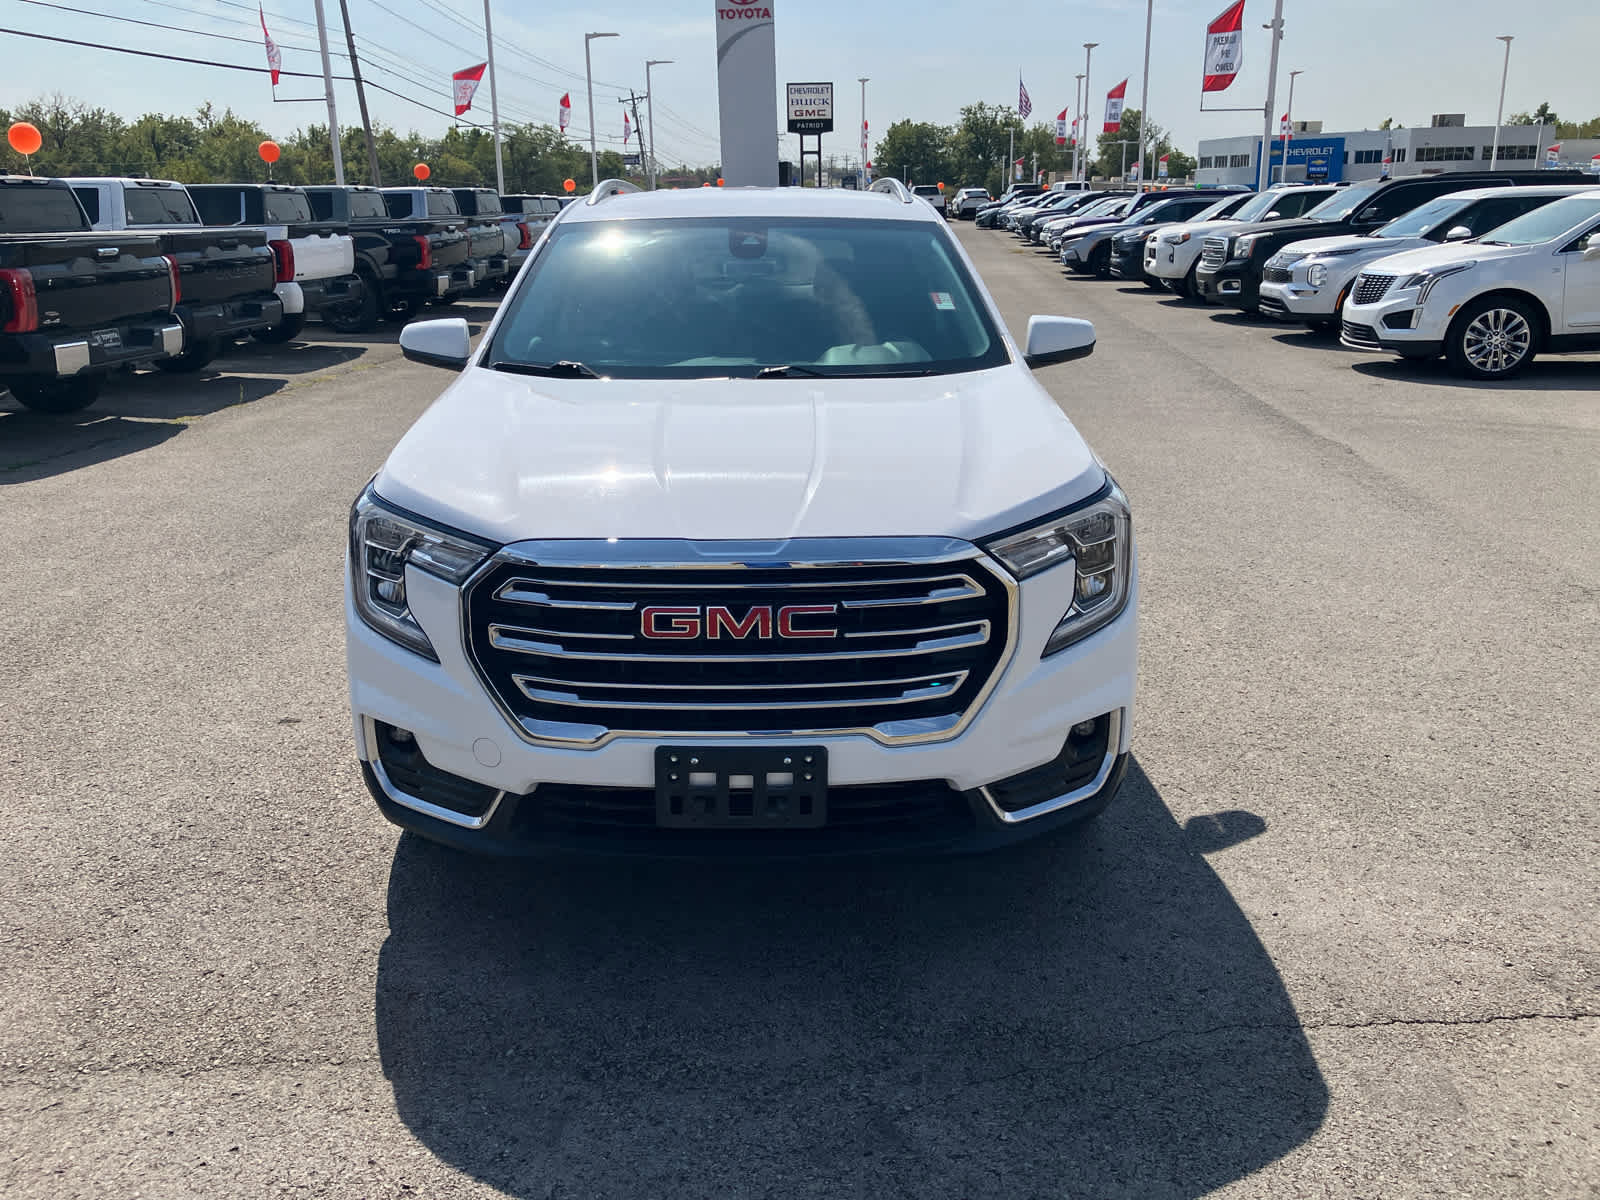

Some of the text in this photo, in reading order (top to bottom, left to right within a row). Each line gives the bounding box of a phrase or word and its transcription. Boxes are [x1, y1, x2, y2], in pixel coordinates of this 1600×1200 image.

[718, 8, 771, 20] TOYOTA
[790, 87, 829, 95] CHEVROLET
[791, 98, 830, 106] BUICK
[794, 109, 826, 117] GMC
[640, 604, 838, 640] GMC
